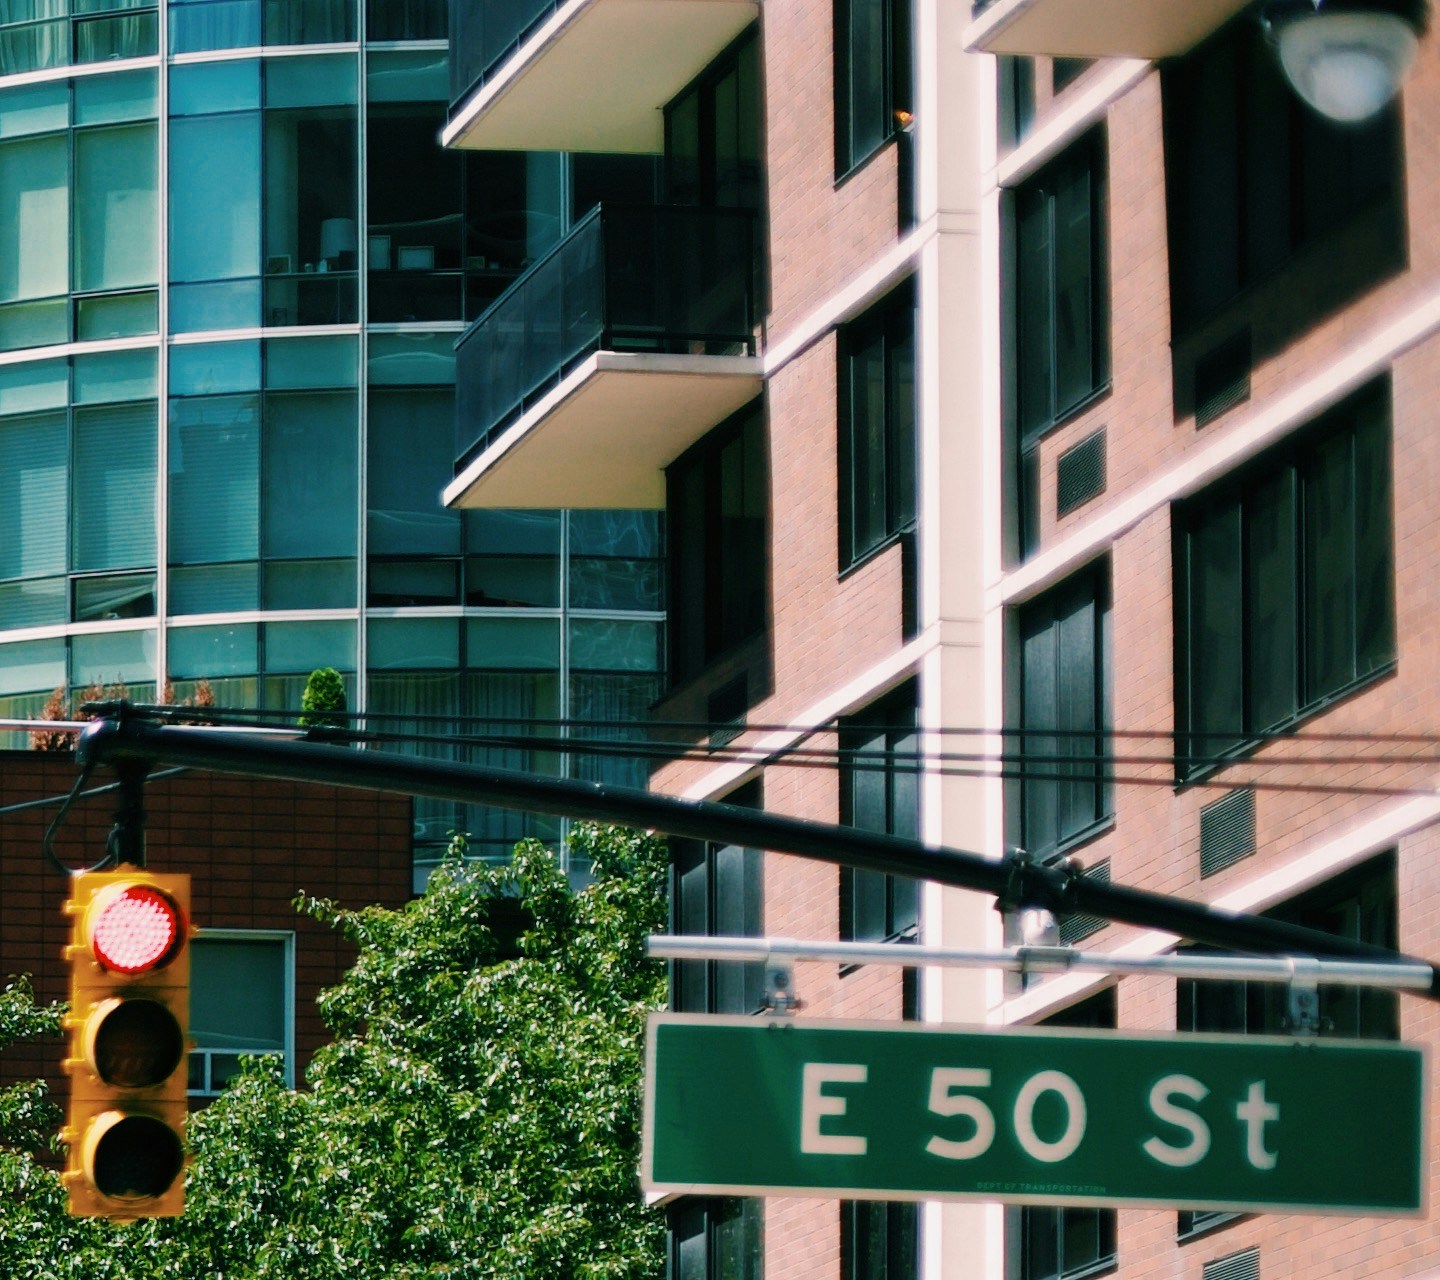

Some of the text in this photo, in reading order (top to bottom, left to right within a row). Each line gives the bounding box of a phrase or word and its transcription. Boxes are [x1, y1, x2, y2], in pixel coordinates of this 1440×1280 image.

[800, 1062, 1281, 1172] E 50 St
[1019, 1183, 1107, 1193] TRANSPORTATION
